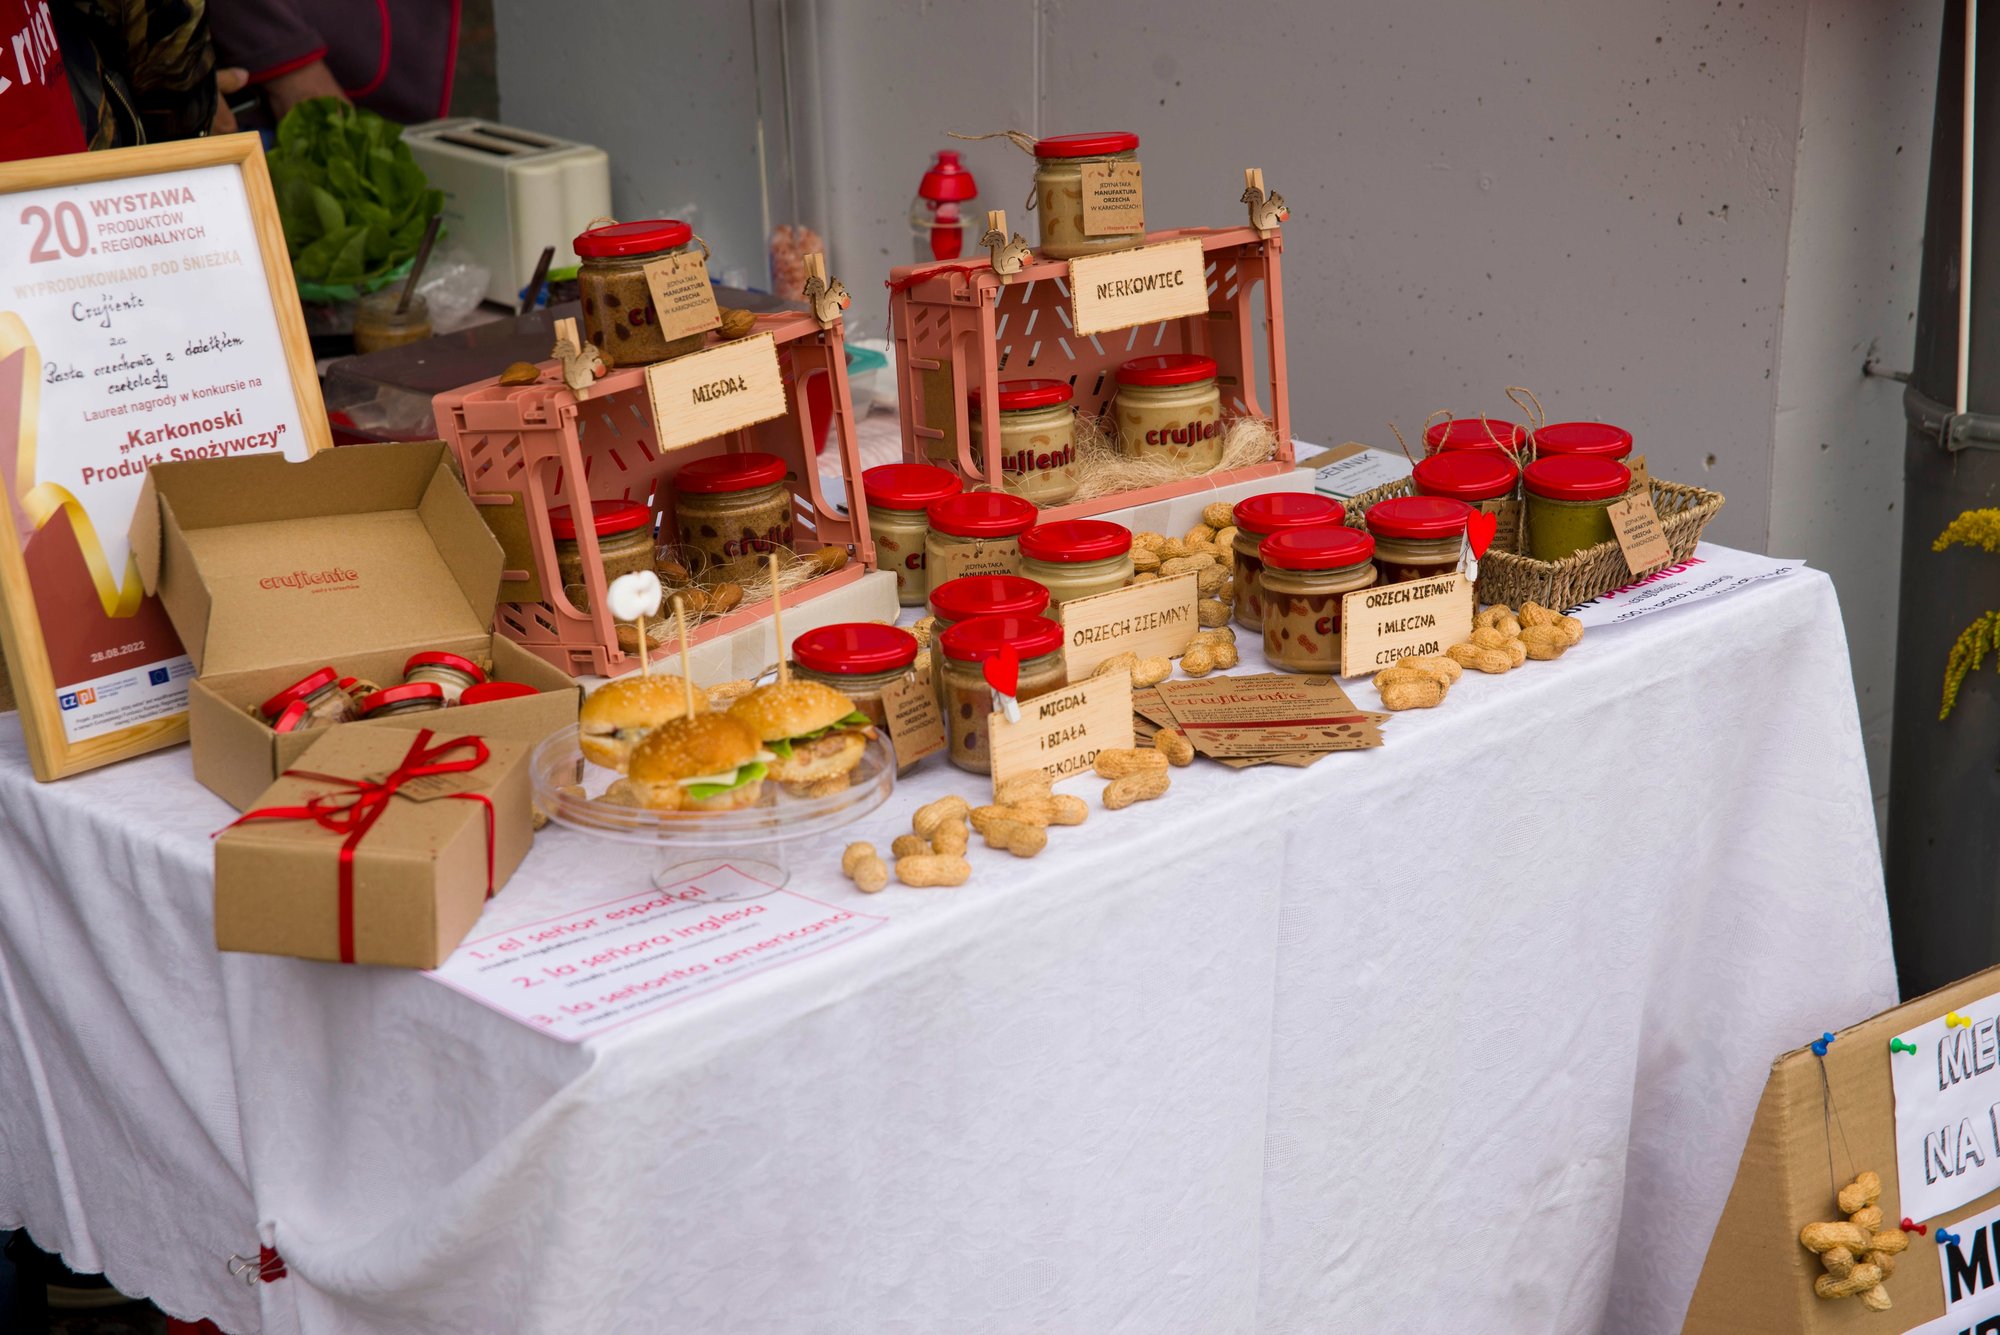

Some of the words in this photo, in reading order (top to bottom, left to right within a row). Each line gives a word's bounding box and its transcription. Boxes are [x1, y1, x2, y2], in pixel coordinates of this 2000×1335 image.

[20, 199, 97, 264] 20.
[90, 186, 196, 217] WYSTAWA
[97, 210, 184, 236] PRODUKTÓW
[101, 226, 206, 253] REGIONALNYCH
[13, 265, 148, 299] WYPRODUKOWANO
[152, 260, 179, 277] POD
[183, 249, 243, 271] ŚNIEŻKĄ
[1096, 269, 1184, 300] NERKOWIEC
[663, 281, 705, 298] MANUFAKTURA
[673, 291, 701, 303] ORZECHA
[109, 336, 127, 346] za
[44, 361, 85, 384] Pasta
[83, 403, 128, 423] Laureat
[131, 394, 177, 414] nagrody
[180, 391, 189, 402] w
[192, 380, 246, 400] konkursie
[248, 377, 262, 389] na
[692, 375, 747, 405] MIGDAŁ
[81, 453, 164, 485] Produkt
[259, 568, 359, 589] crujiente
[1366, 589, 1411, 609] ORZECH
[1412, 580, 1456, 600] ZIEMNY
[1073, 617, 1130, 647] ORZECH
[1134, 603, 1191, 633] ZIEMNY
[1384, 614, 1436, 634] MLECZNA
[1375, 641, 1440, 665] CZEKOLADA
[1039, 692, 1087, 720] MIGDAŁ
[1171, 691, 1307, 706] crujiente
[1047, 723, 1086, 748] BIAŁA
[469, 951, 495, 960] 1.
[498, 937, 525, 951] el
[542, 963, 579, 978] la
[670, 904, 767, 938] inglesa
[558, 1000, 596, 1016] la
[713, 911, 854, 965] americana
[1938, 1014, 2000, 1091] ME
[1924, 1117, 1985, 1186] NA
[1945, 1220, 2000, 1304] M
